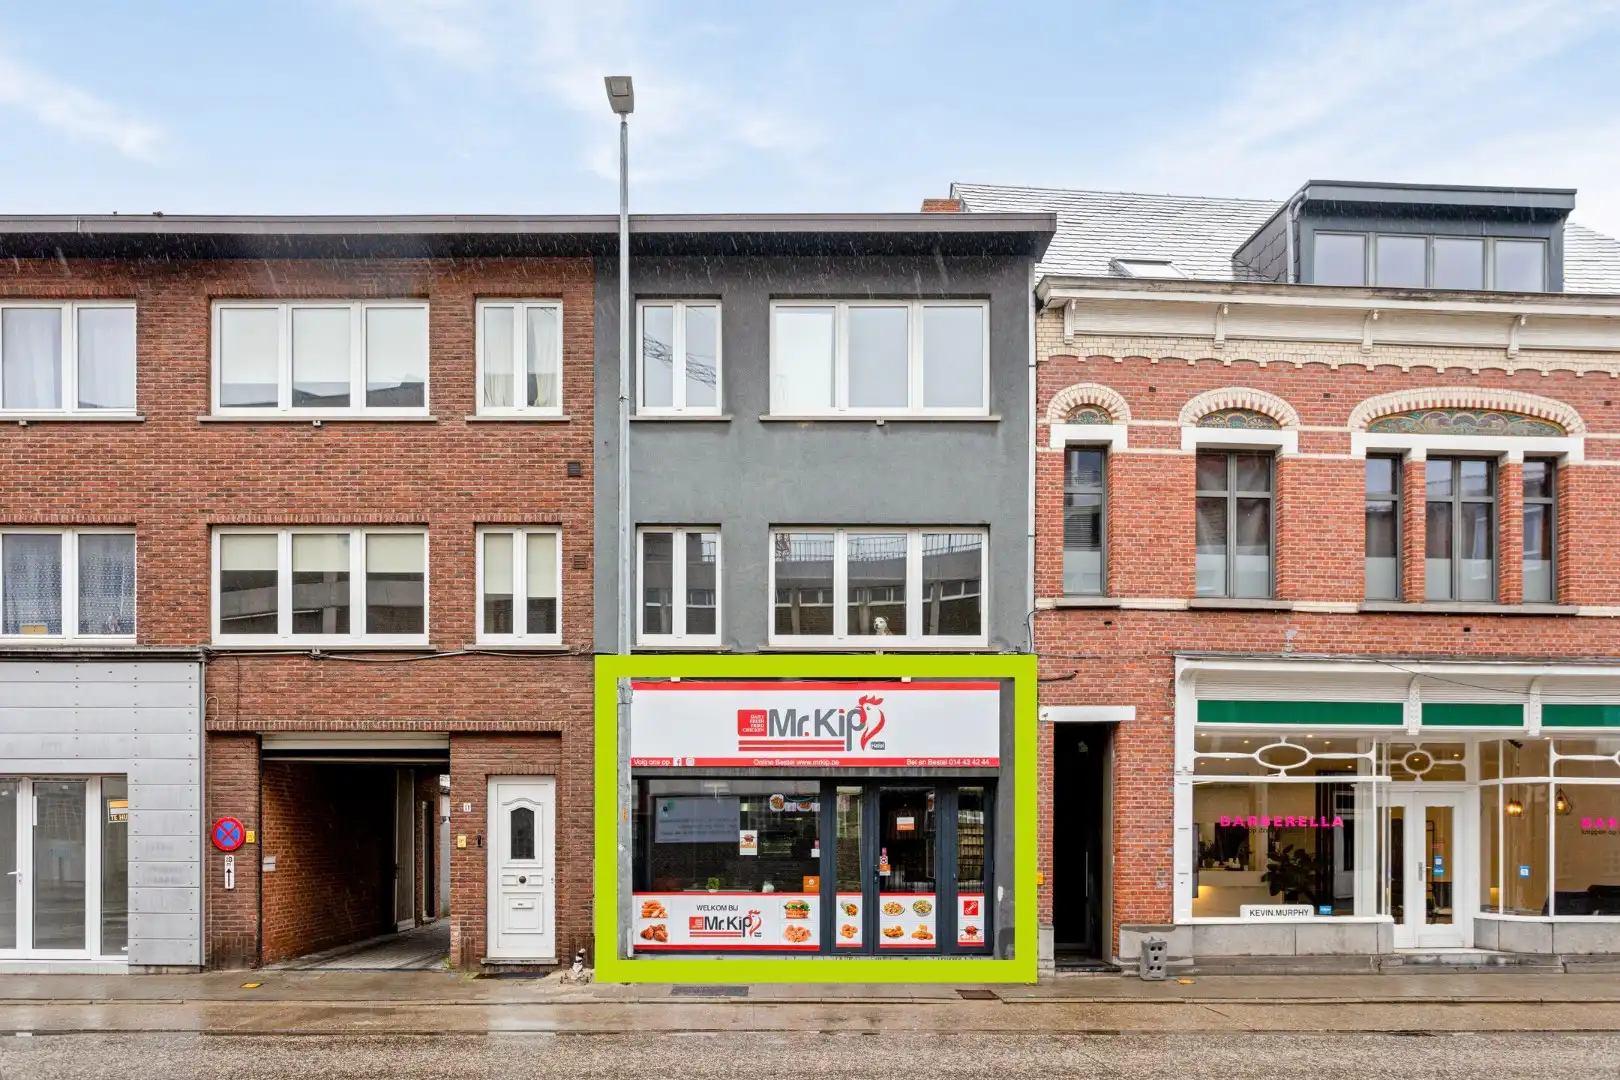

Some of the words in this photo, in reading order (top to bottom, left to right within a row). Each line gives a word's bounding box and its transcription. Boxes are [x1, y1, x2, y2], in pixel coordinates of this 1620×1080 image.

[769, 709, 809, 737] Mr.
[814, 708, 867, 752] Kip
[633, 758, 648, 767] Volg
[796, 759, 840, 767] www.mrkip.be
[928, 758, 948, 766] Bestel
[1220, 815, 1345, 828] BARBERELLA
[1249, 909, 1309, 917] KEVIN.MURPHY
[704, 916, 725, 931] Mr.
[727, 916, 753, 938] Kip
